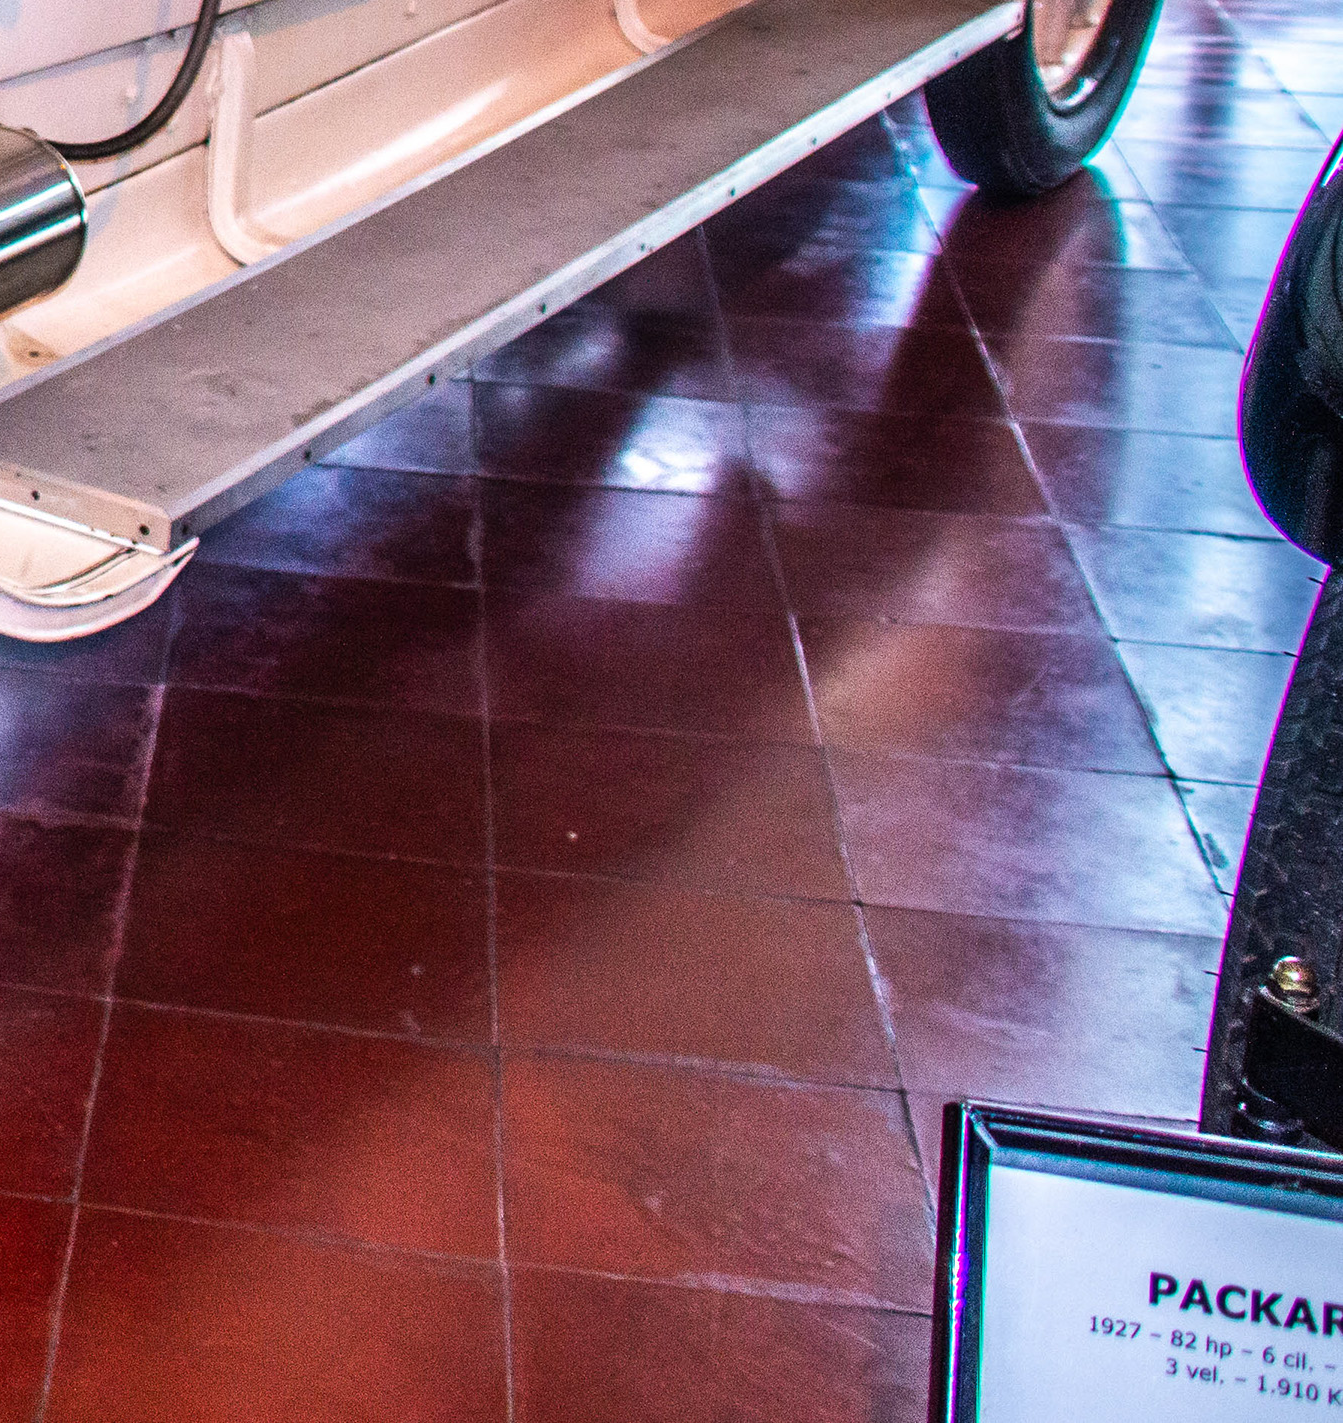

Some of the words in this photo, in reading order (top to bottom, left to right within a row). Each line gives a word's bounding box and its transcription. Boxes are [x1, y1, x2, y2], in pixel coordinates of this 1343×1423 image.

[1148, 1272, 1343, 1337] PACKAR
[1090, 1315, 1141, 1340] 1927
[1170, 1330, 1197, 1350] 82
[1206, 1335, 1232, 1359] hp
[1262, 1346, 1275, 1364] 6
[1283, 1350, 1314, 1372] cil.
[1165, 1358, 1177, 1376] 3
[1186, 1362, 1224, 1383] vel.
[1258, 1375, 1319, 1403] 1.910
